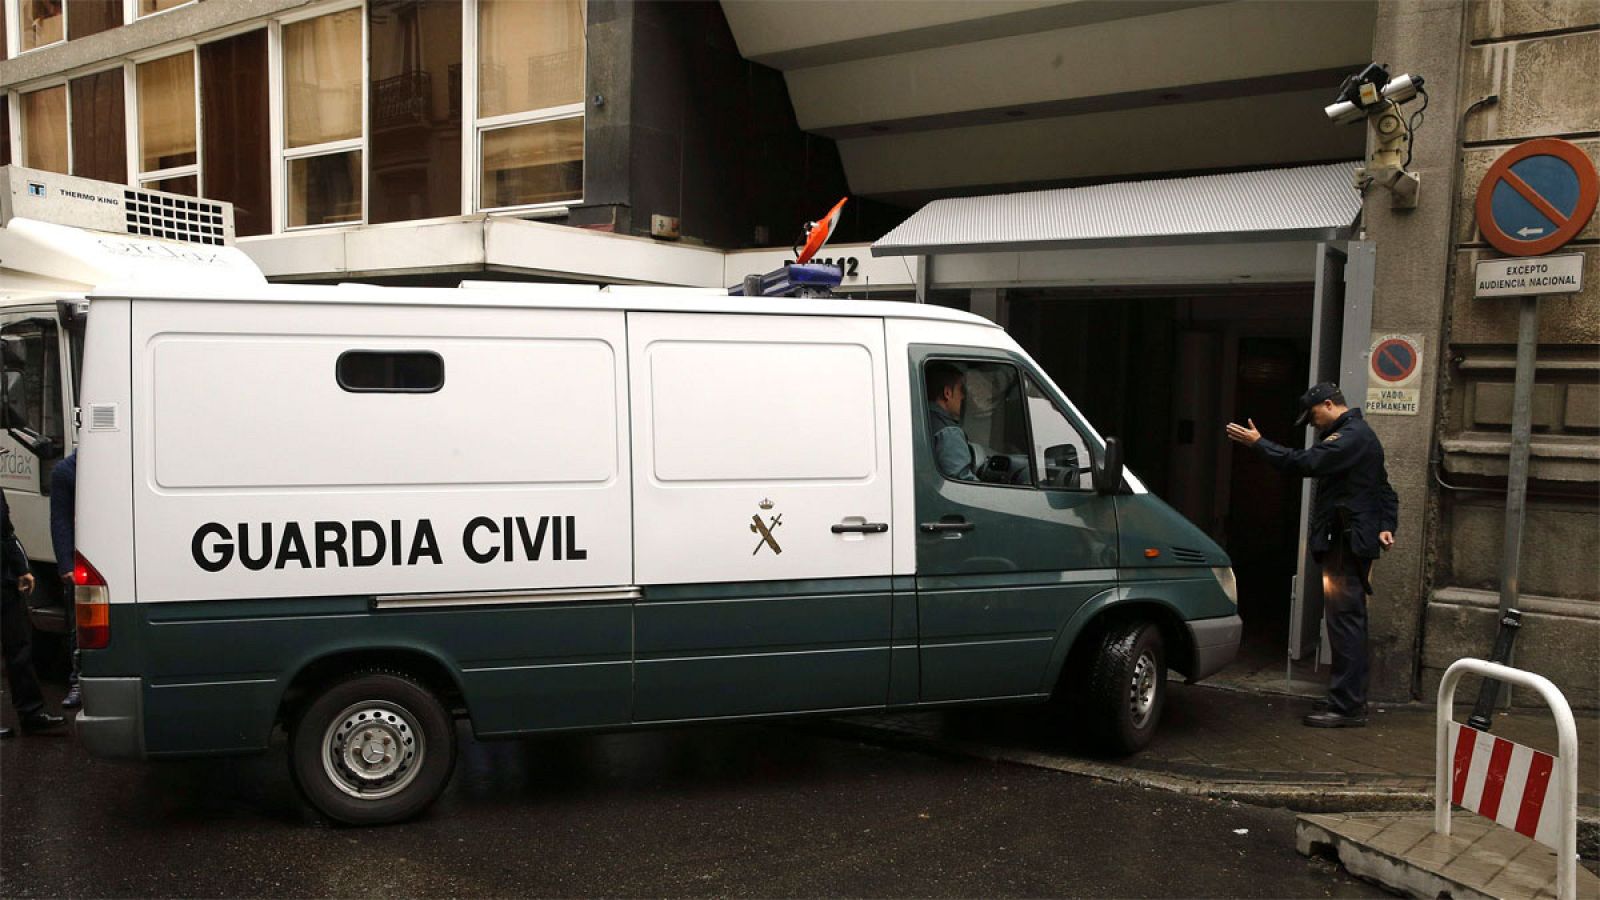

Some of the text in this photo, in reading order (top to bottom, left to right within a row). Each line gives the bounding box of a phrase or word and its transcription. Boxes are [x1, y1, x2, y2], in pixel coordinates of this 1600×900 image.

[60, 189, 119, 206] THERMO KING
[837, 256, 859, 277] 12
[1506, 264, 1549, 276] EXCEPTO
[1479, 275, 1577, 290] AUDIENCIA NACIONAL
[1381, 390, 1405, 399] VADO
[1366, 401, 1416, 412] PERMANENTE
[191, 514, 588, 573] GUARDIA CIVIL
